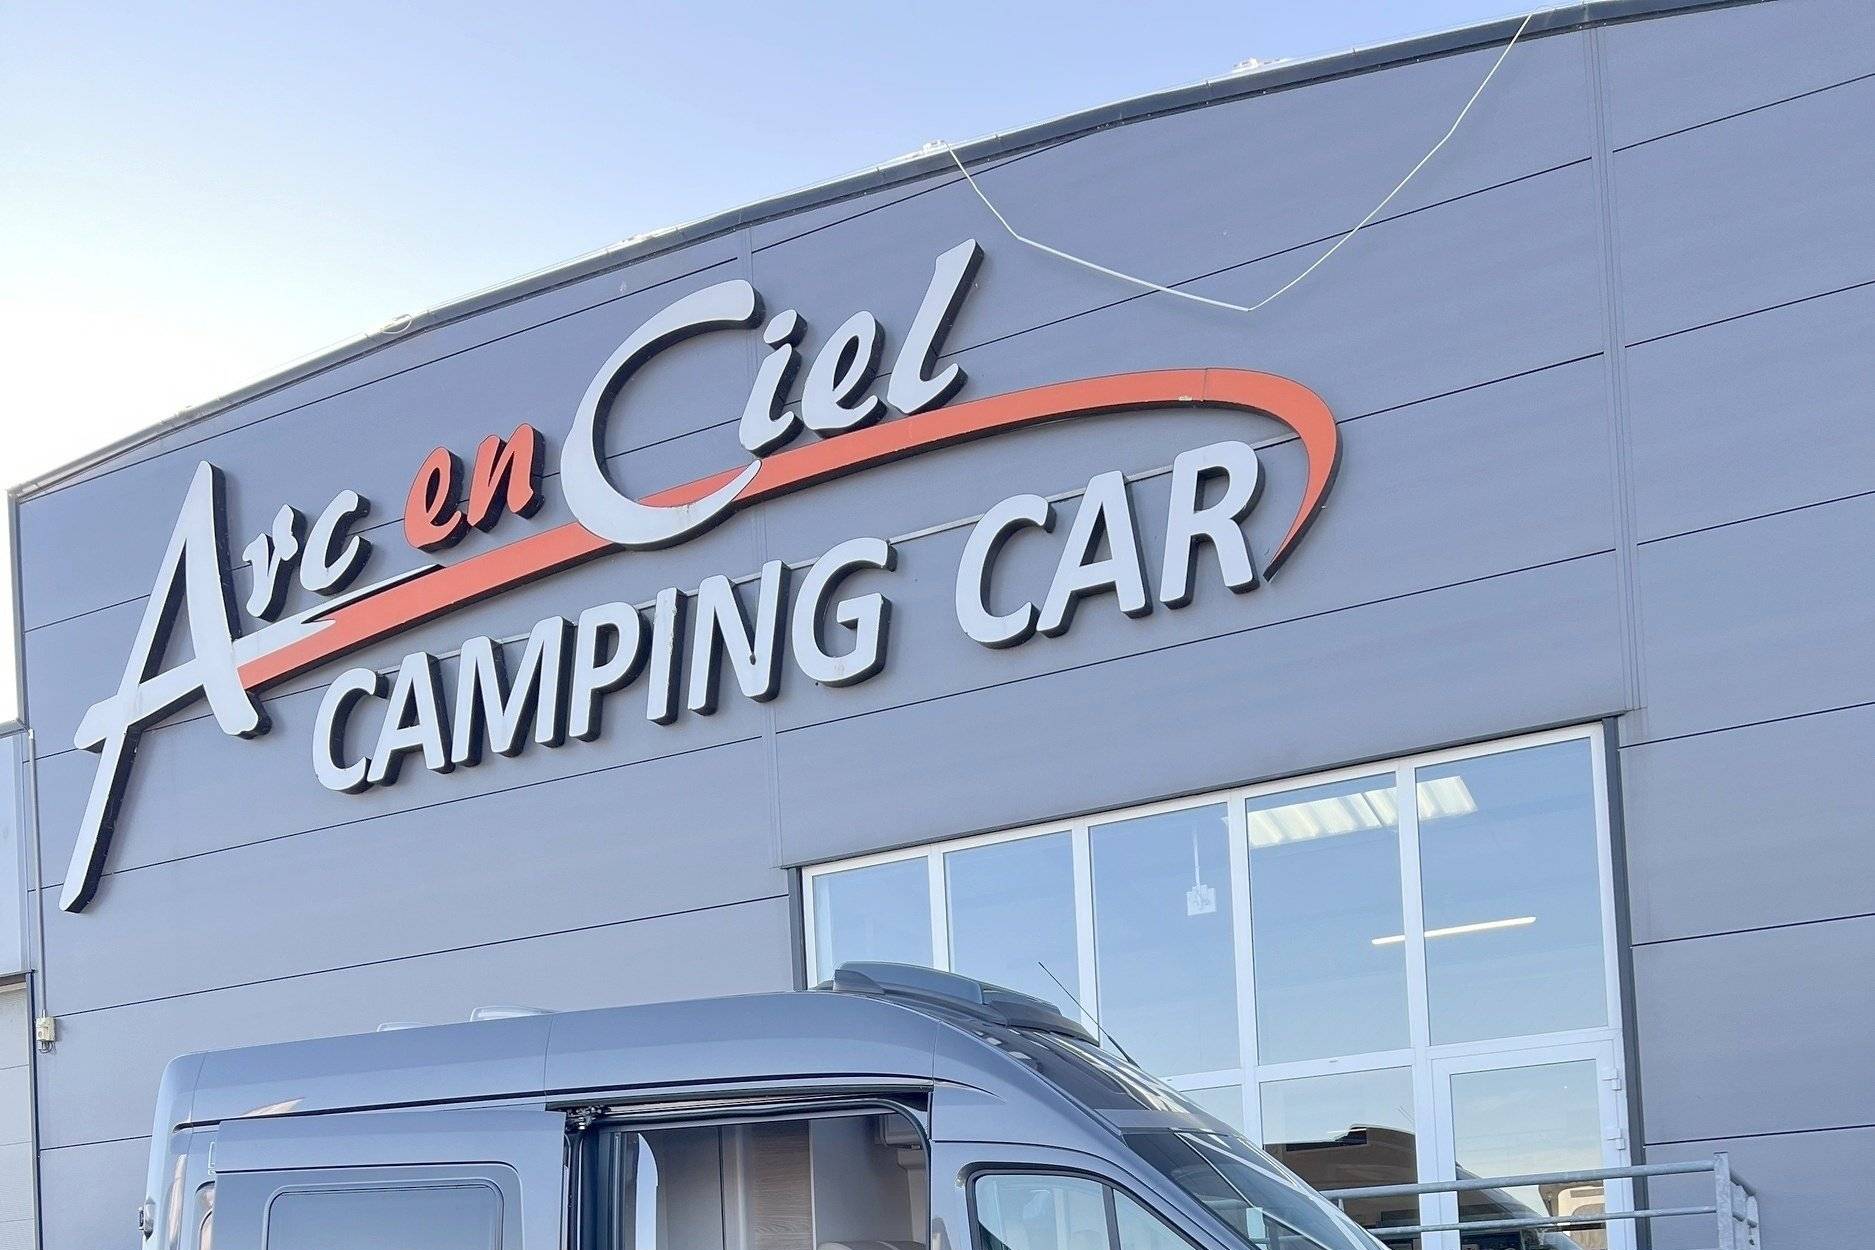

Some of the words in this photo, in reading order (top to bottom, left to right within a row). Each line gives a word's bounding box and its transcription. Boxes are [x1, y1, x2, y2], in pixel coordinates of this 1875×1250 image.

[60, 460, 372, 914] Arc
[404, 423, 545, 551] en
[560, 238, 984, 550] Ciel
[313, 537, 896, 795] CAMPING
[956, 440, 1265, 650] CAR
